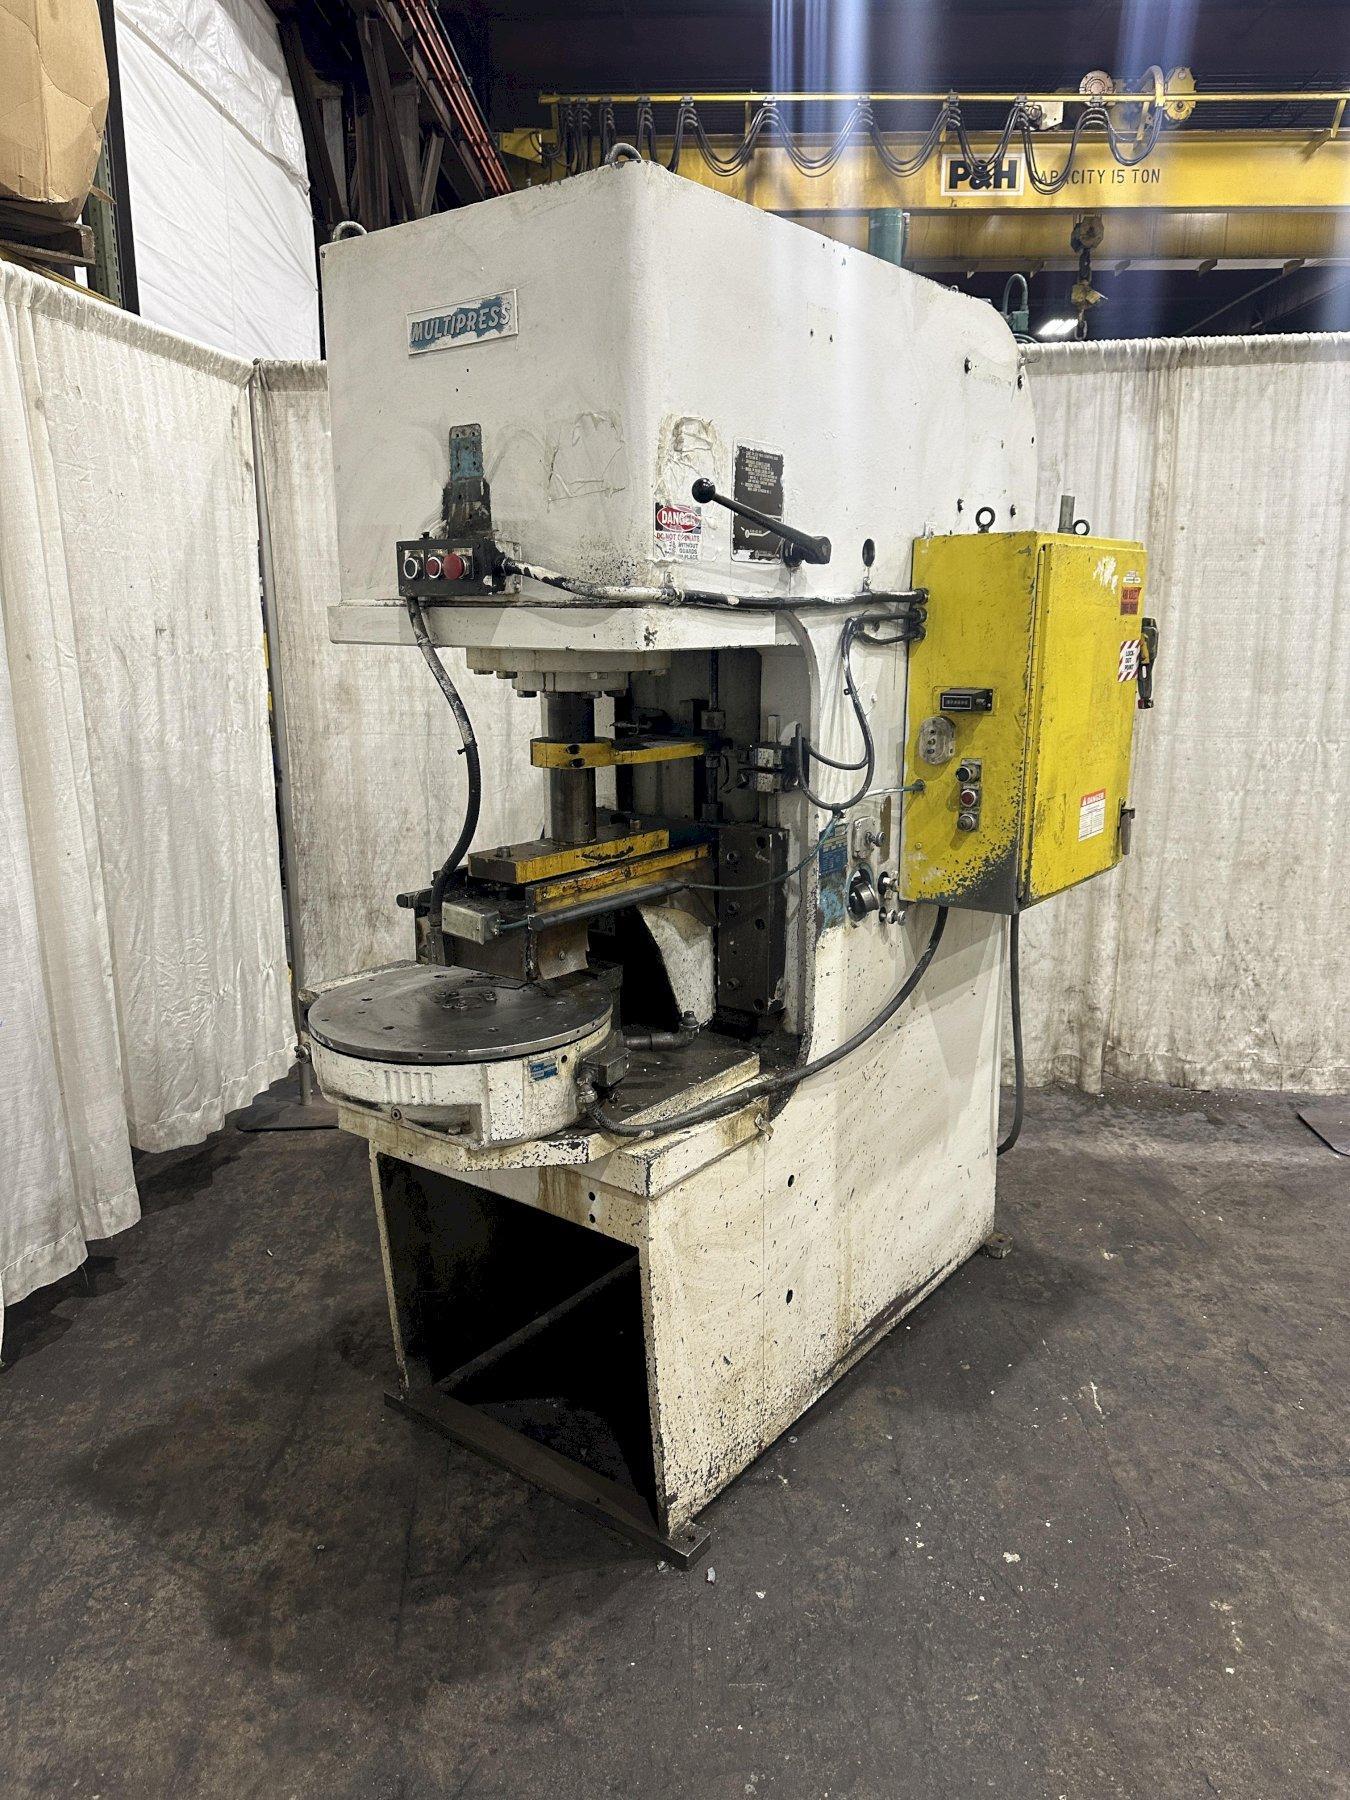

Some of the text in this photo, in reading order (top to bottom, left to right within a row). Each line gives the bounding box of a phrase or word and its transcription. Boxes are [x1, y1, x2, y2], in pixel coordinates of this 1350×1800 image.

[948, 160, 1016, 190] P&H
[1111, 169, 1125, 183] 15
[1132, 168, 1160, 183] TON
[411, 300, 512, 342] MULTIPRESS
